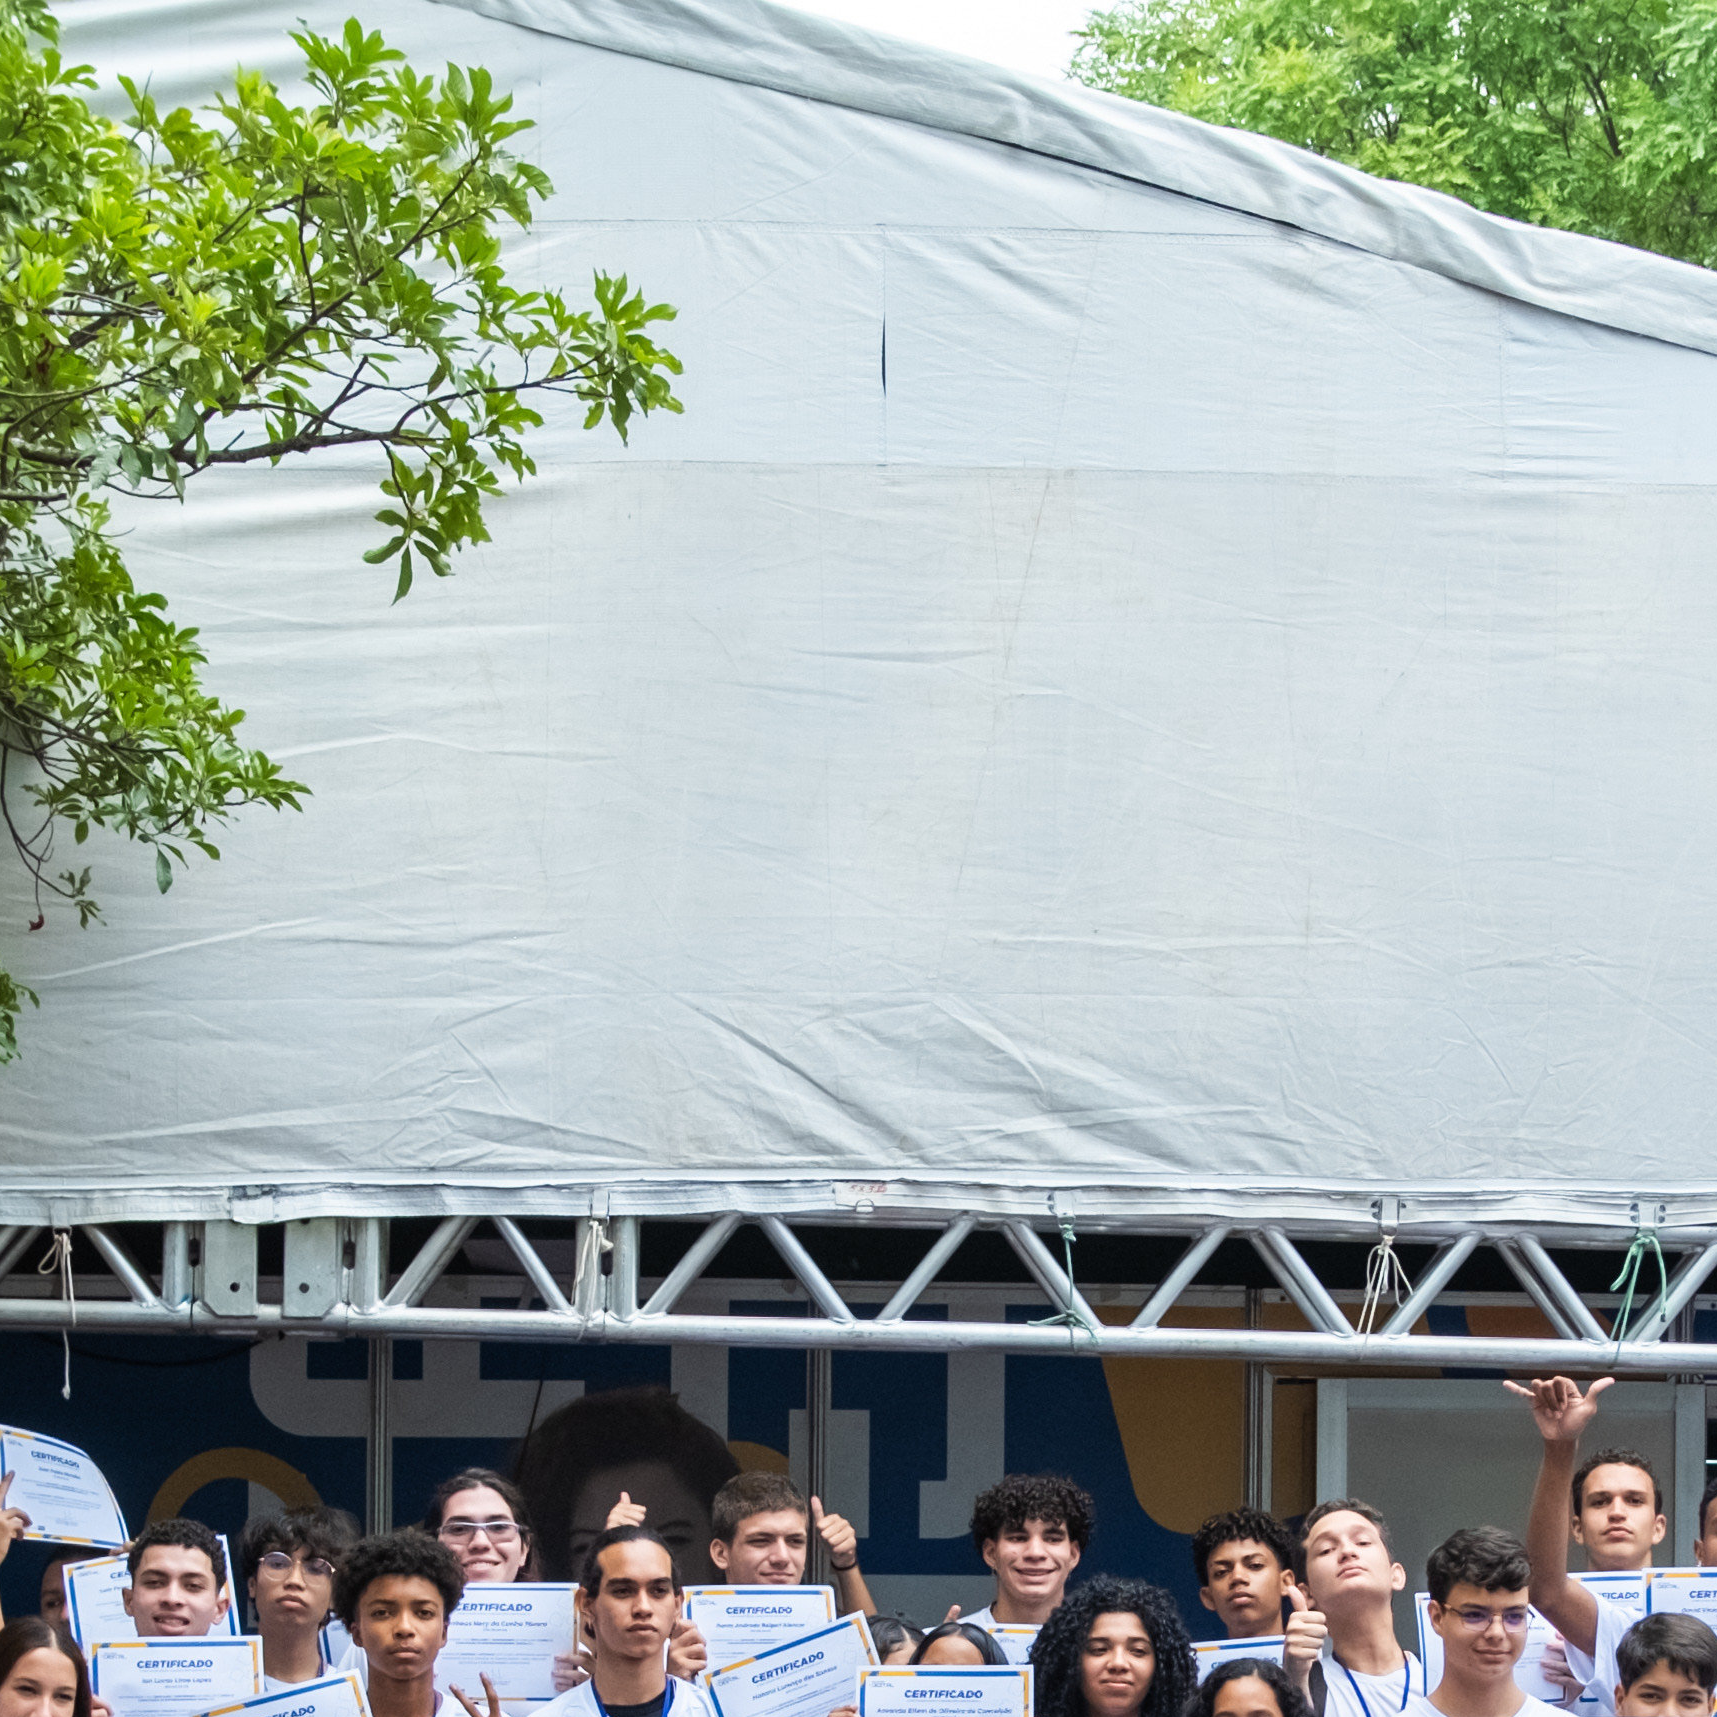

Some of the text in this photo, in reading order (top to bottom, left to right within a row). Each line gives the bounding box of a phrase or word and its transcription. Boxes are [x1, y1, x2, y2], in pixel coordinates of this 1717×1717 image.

[1599, 1590, 1640, 1601] FICADO
[455, 1603, 533, 1612] CERTIFICADO
[726, 1606, 793, 1615] CERTIFICADO
[136, 1659, 214, 1669] CERTIFICADO
[751, 1651, 825, 1684] CERTIFICADO
[904, 1689, 983, 1699] CERTIFICADO
